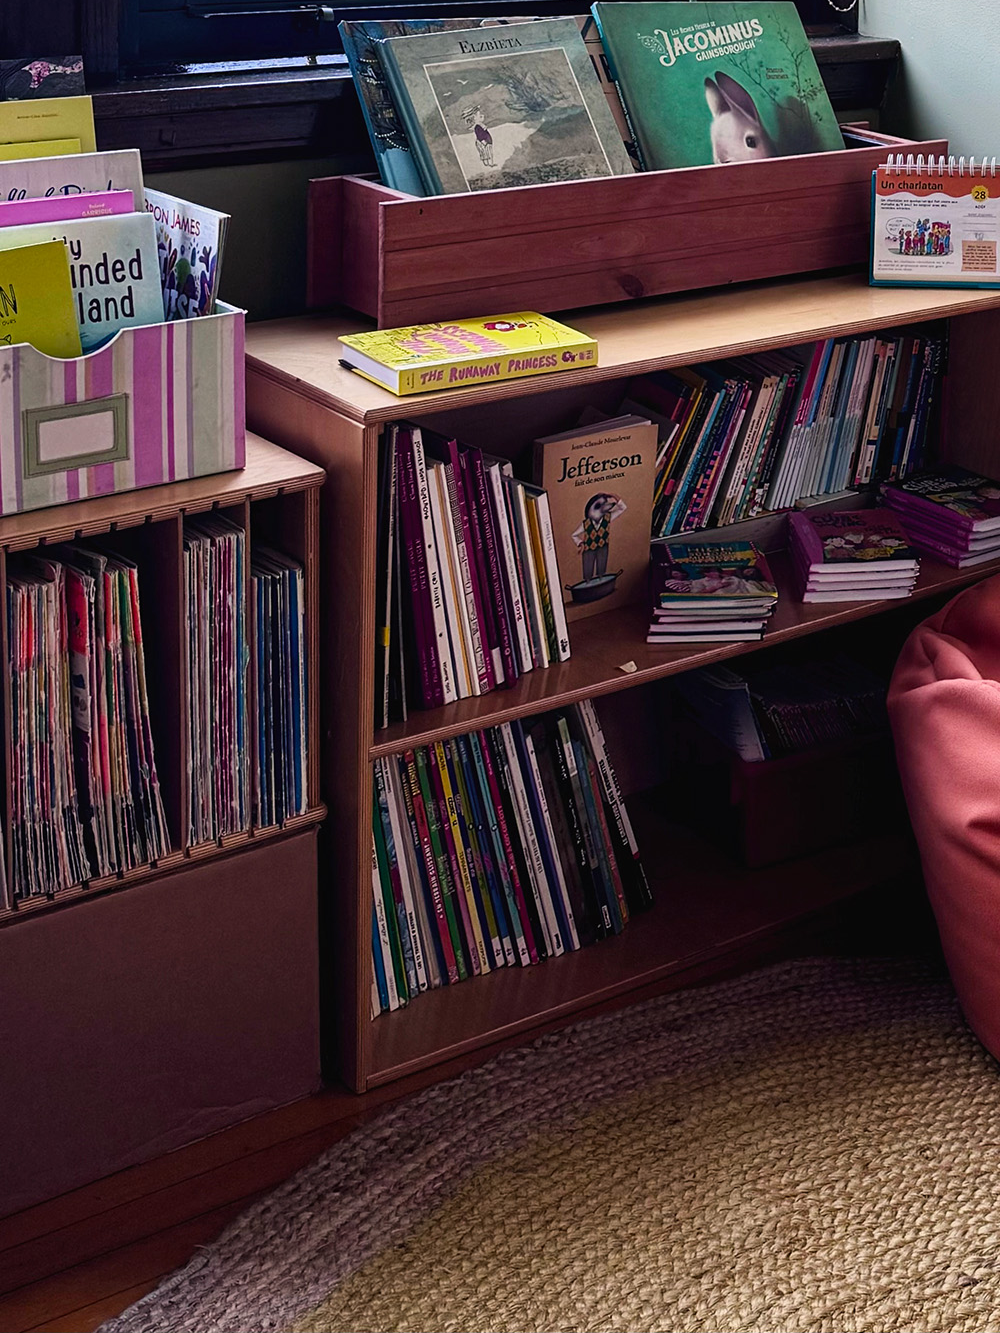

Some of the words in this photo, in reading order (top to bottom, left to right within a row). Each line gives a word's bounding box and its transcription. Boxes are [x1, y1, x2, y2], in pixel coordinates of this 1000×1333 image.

[654, 18, 763, 67] JACOMINUS
[695, 39, 756, 62] GAINSBOROUGH
[881, 181, 895, 189] Un
[898, 181, 944, 190] charlatan
[974, 191, 986, 200] 28
[171, 209, 201, 237] JAMES
[420, 369, 444, 386] THE
[448, 363, 501, 383] RUNAWAY
[507, 354, 558, 373] PRINCESS
[557, 453, 643, 483] Jefferson
[574, 476, 585, 487] fait
[585, 476, 593, 485] de
[593, 475, 605, 483] son
[605, 471, 626, 481] mieux
